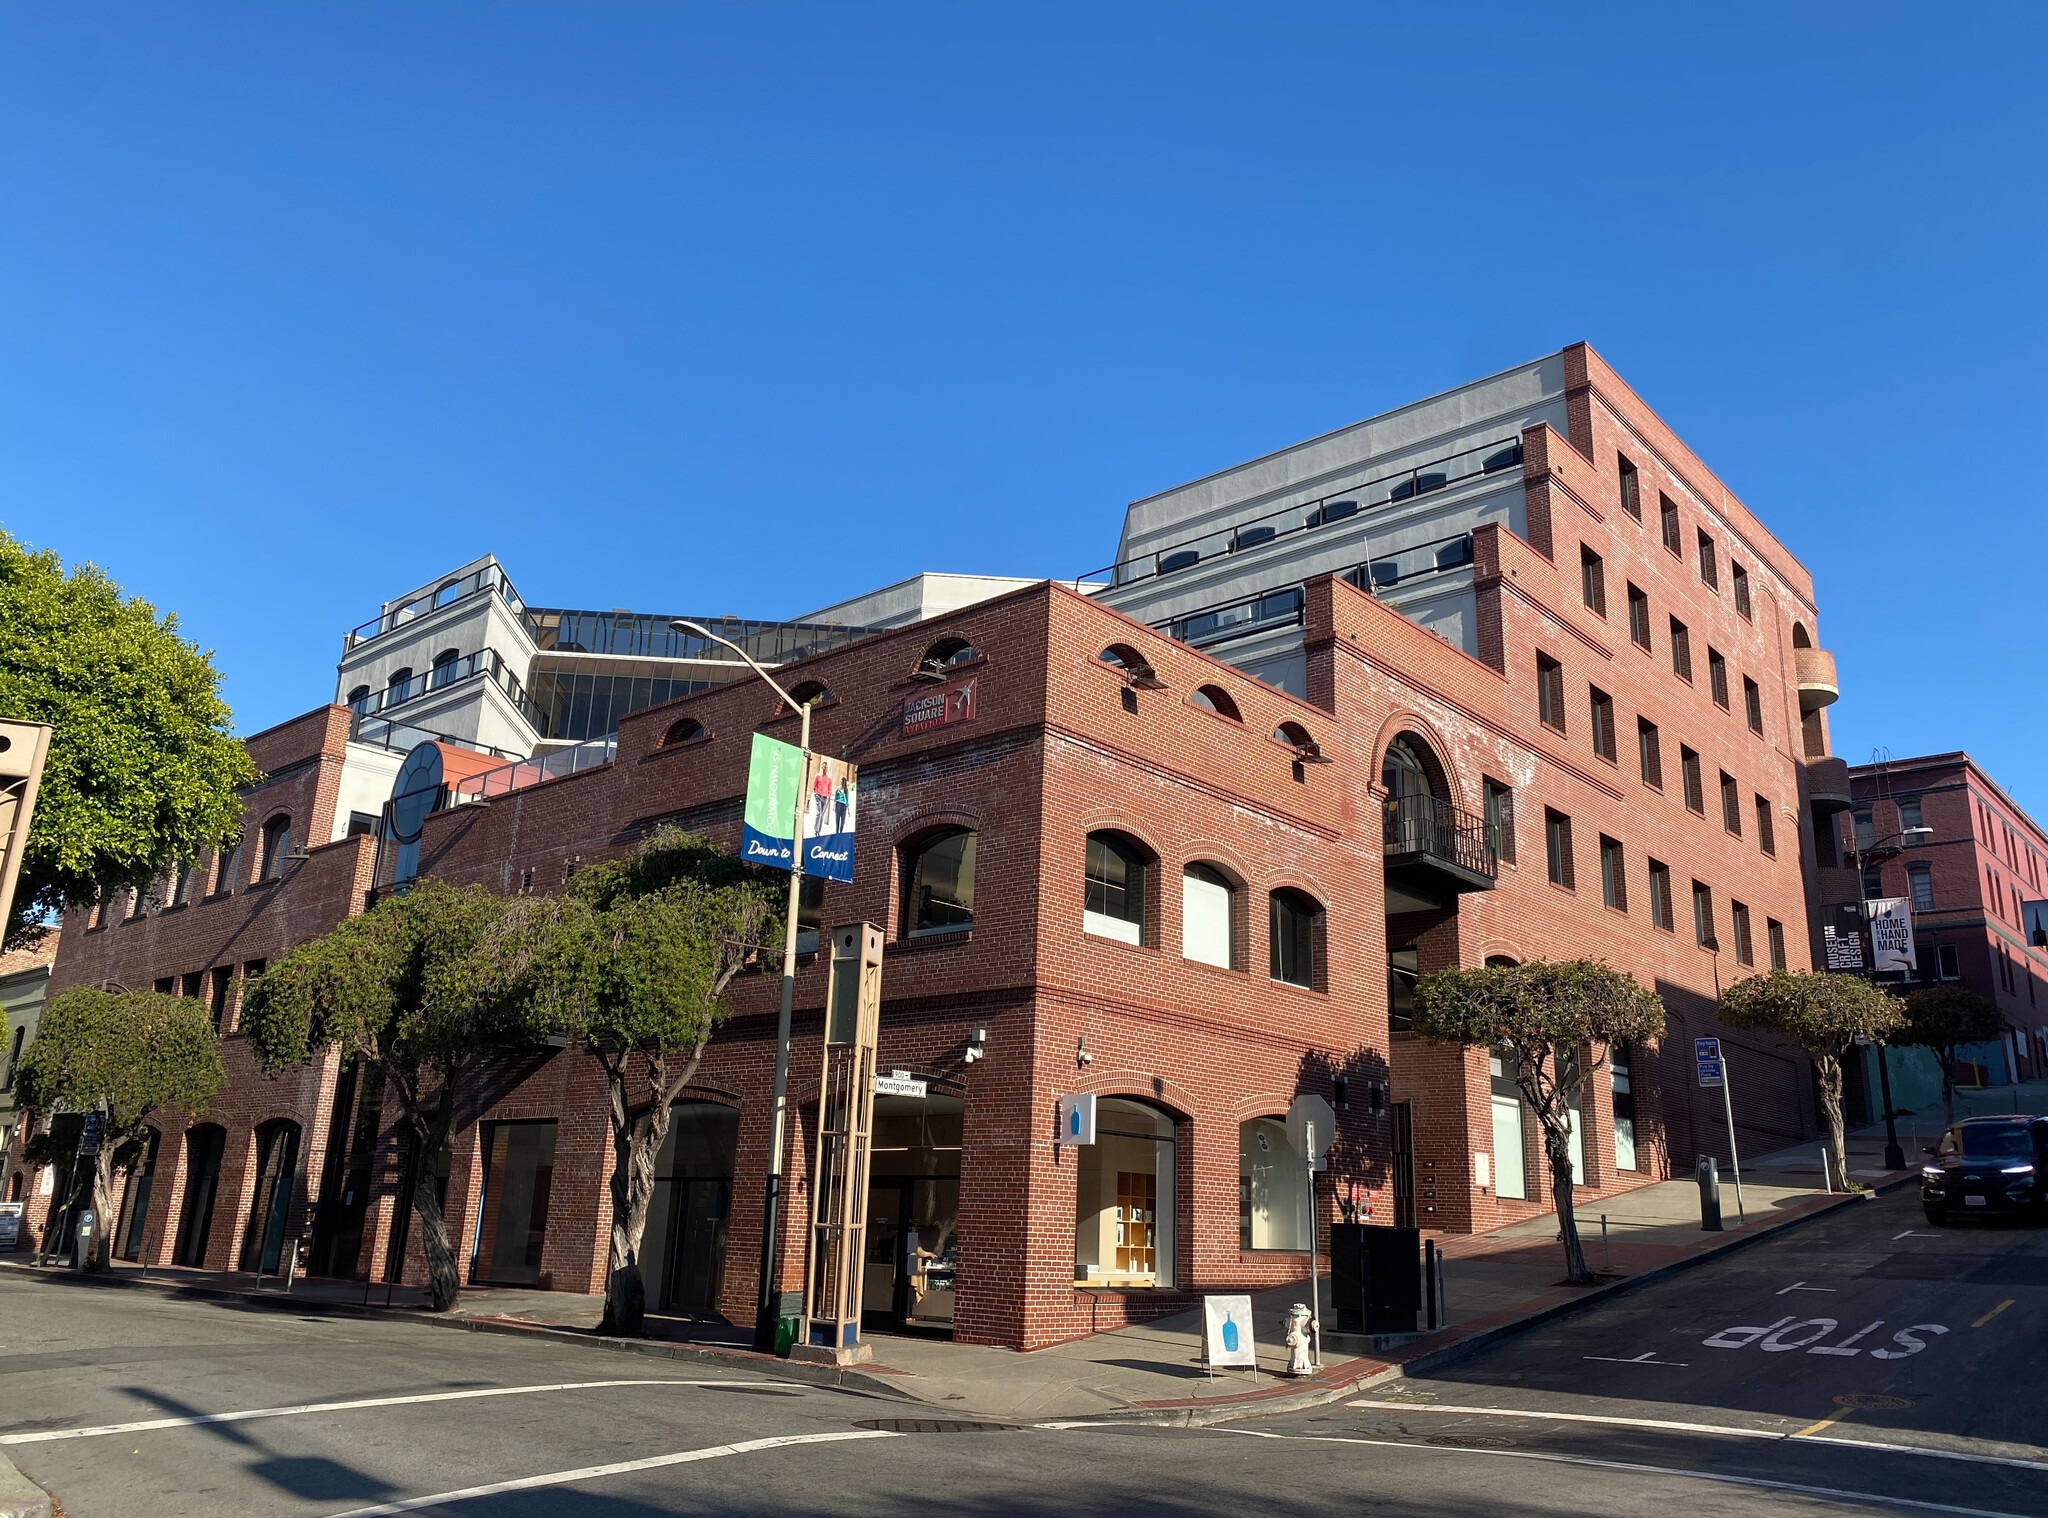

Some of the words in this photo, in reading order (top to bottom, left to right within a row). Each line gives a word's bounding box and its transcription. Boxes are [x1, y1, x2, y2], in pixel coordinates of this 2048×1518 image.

[906, 693, 945, 713] JACKSON
[905, 705, 944, 725] SQUARE
[766, 765, 779, 832] DOWNTOWN
[748, 840, 778, 857] Down
[781, 848, 791, 858] to
[810, 845, 848, 861] Connect
[1875, 918, 1906, 930] HOME
[1881, 929, 1909, 940] HAND
[1824, 926, 1840, 969] MUSEUM
[1837, 937, 1851, 968] CRAFT
[1848, 931, 1863, 967] DESIGN
[1877, 939, 1907, 951] MADE
[895, 1071, 904, 1079] 900
[878, 1080, 923, 1095] Montgomery
[1702, 1316, 1950, 1360] STOP
